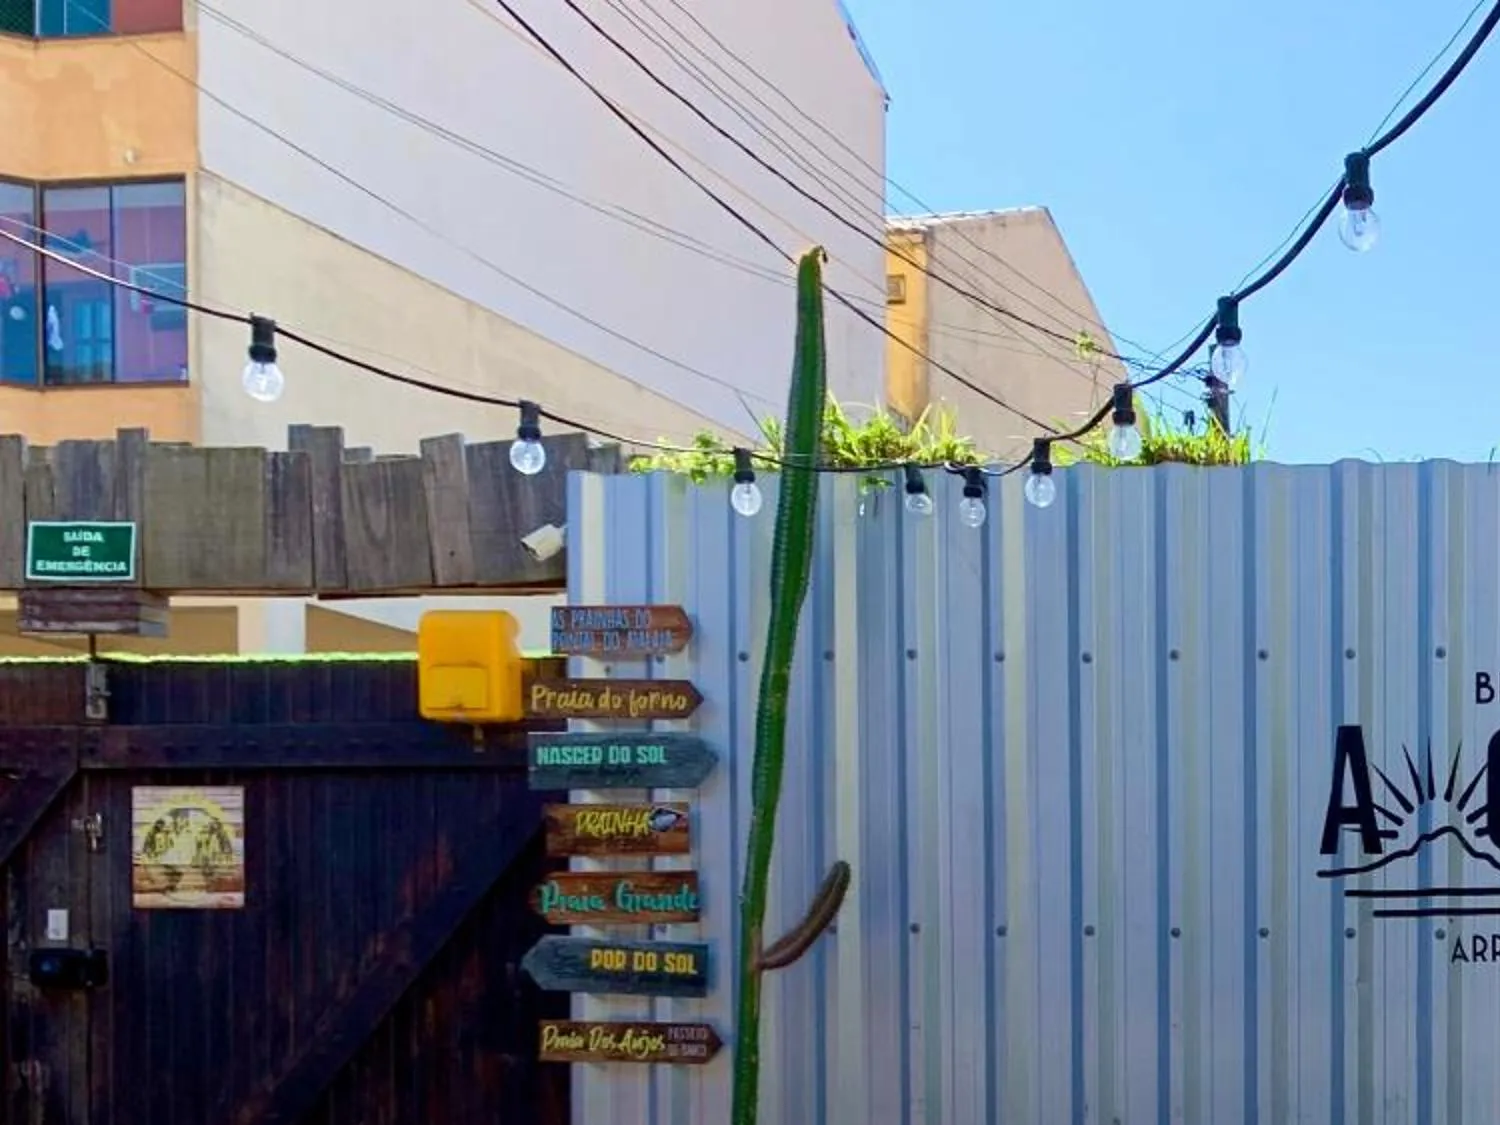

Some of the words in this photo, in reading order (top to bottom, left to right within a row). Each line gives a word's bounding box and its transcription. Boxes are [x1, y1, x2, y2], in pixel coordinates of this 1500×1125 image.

[63, 529, 105, 543] SAÍDA
[36, 557, 127, 573] EMERGÊNCIA
[72, 545, 91, 557] DE
[531, 683, 594, 713] Praia
[598, 686, 622, 711] do
[536, 745, 602, 766] NASCER
[608, 745, 631, 764] DO
[637, 745, 668, 765] SOL
[1319, 725, 1383, 855] A
[575, 806, 650, 836] PRAINHA
[540, 880, 606, 914] Praia
[615, 879, 699, 913] Grande
[590, 949, 625, 971] POR
[633, 951, 657, 973] DO
[664, 953, 698, 975] SOL
[542, 1024, 584, 1052] Praia
[616, 1028, 666, 1059] Anjos
